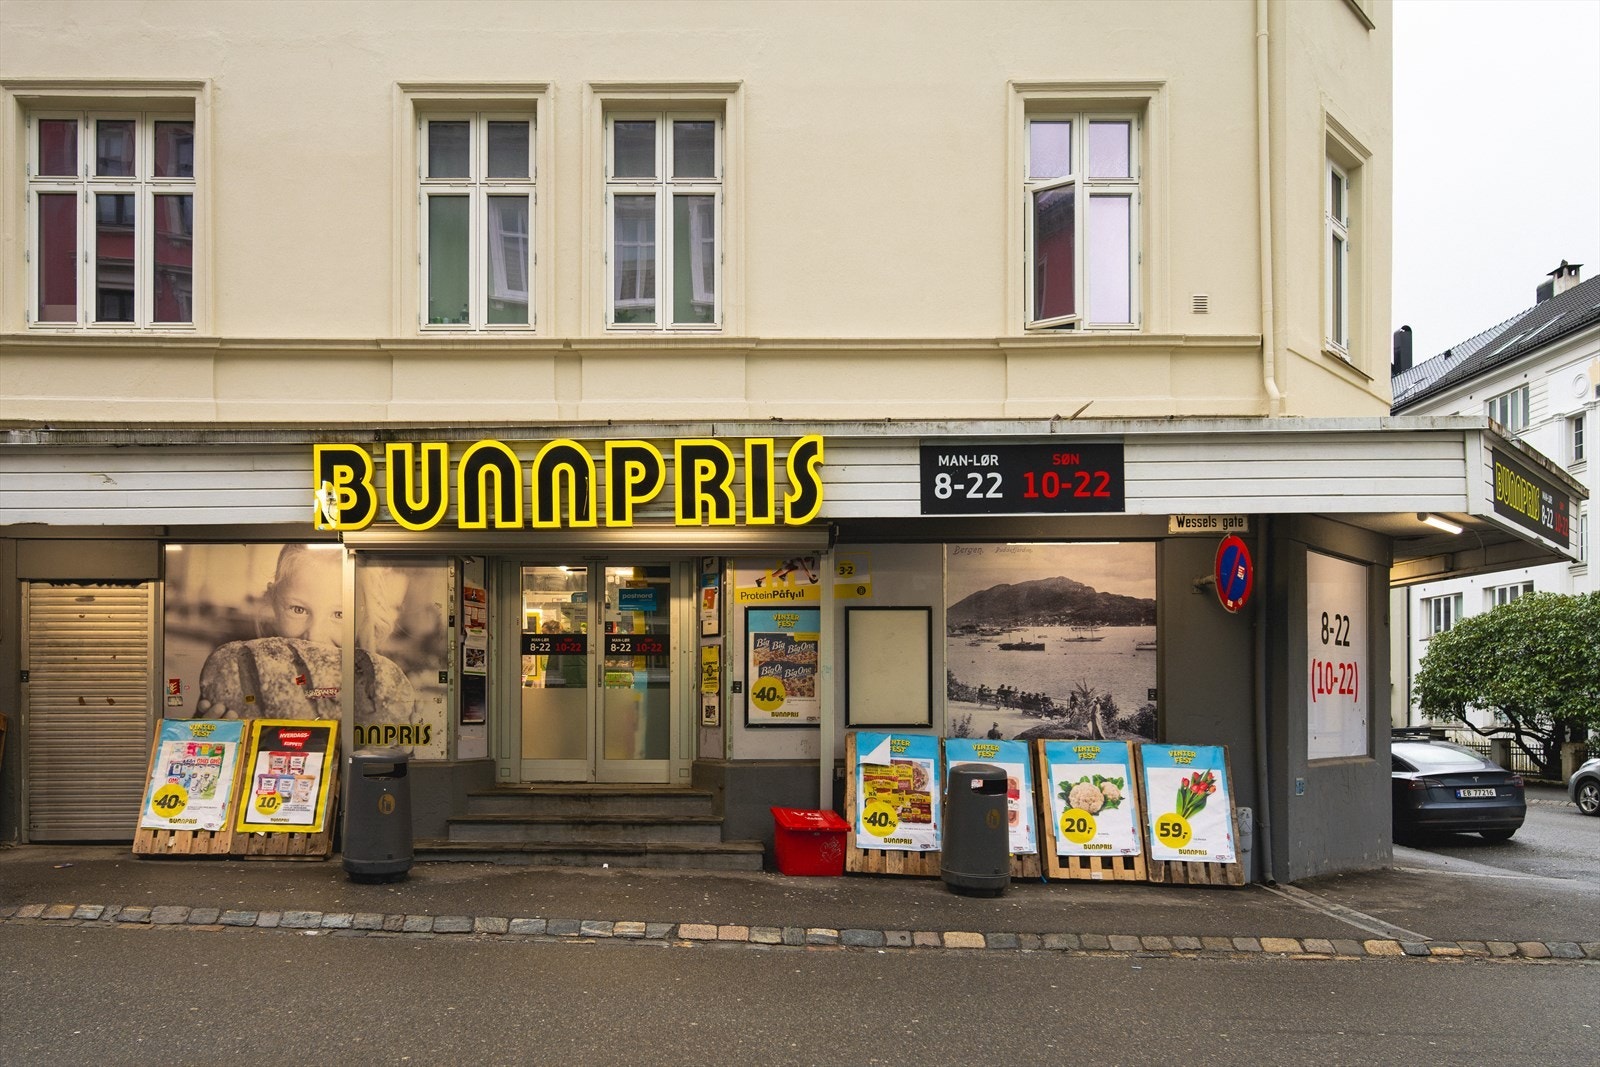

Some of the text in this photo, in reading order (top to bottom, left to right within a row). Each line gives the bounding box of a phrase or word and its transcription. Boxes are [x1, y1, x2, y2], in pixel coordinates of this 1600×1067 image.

[938, 454, 999, 467] MAN-LØR
[1053, 453, 1080, 466] SØN
[314, 435, 824, 530] BUNNPRIS
[934, 472, 1004, 499] 8-22
[1023, 471, 1111, 498] 10-22
[1495, 461, 1540, 521] BUNNPRIS
[1176, 515, 1244, 530] Wessels gate
[1541, 504, 1554, 529] 8-22
[838, 566, 854, 576] 3-2
[622, 592, 654, 601] postnord
[773, 613, 800, 621] VINTER
[777, 620, 796, 628] FEST
[1321, 611, 1350, 647] 8-22
[530, 643, 551, 652] 8-22
[555, 643, 582, 652] 10-22
[610, 643, 631, 652] 8-22
[636, 643, 663, 652] 10-22
[1311, 658, 1359, 703] (10-22)
[753, 686, 784, 702] -40%
[1473, 788, 1494, 797] 77216
[154, 794, 186, 810] -40%
[258, 796, 281, 810] 10,-
[864, 811, 897, 828] -40%
[1064, 817, 1093, 834] 20,-
[1160, 822, 1188, 840] 59,-
[883, 837, 913, 845] BUNNPRIS
